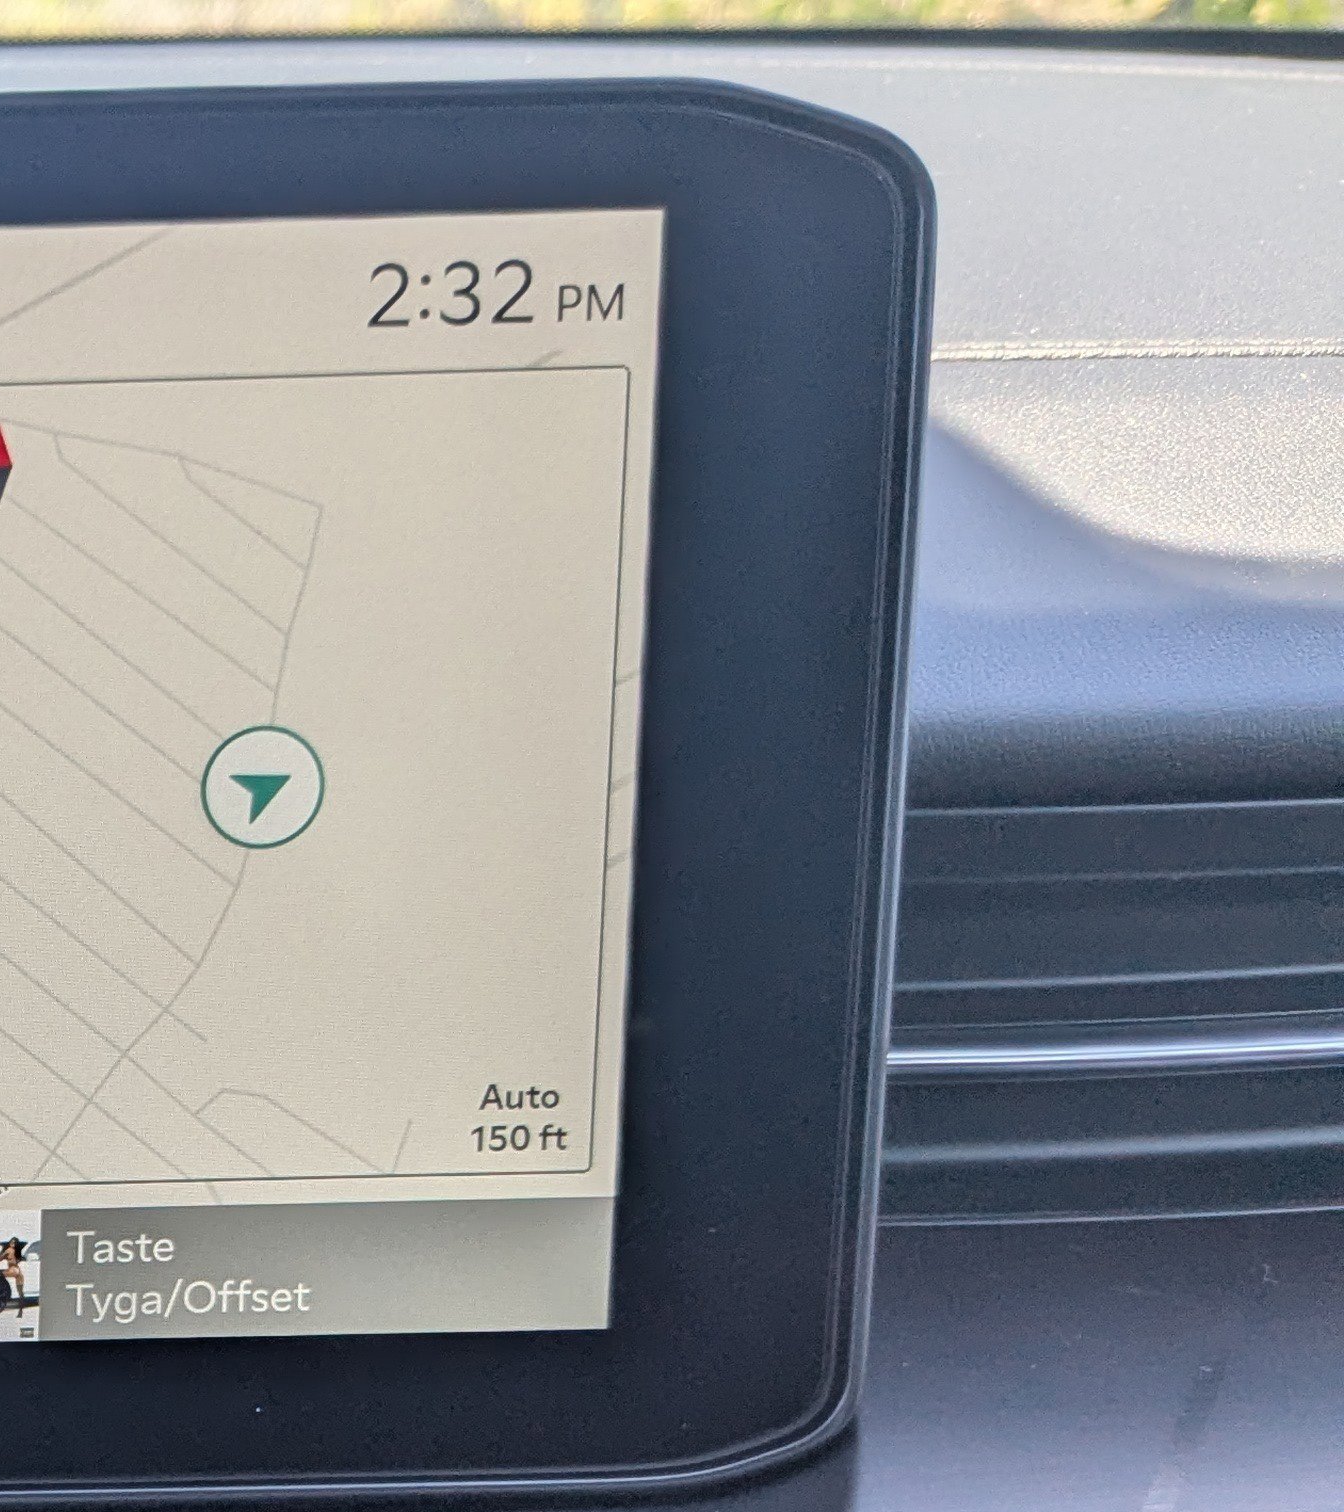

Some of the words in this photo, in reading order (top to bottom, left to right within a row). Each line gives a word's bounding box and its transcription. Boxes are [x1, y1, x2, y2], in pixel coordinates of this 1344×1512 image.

[367, 258, 534, 328] 2:32
[556, 283, 626, 323] PM
[478, 1083, 561, 1111] Auto
[470, 1125, 531, 1153] 150
[538, 1123, 568, 1151] ft
[66, 1229, 176, 1264] Taste
[65, 1279, 313, 1325] Tyga/Offset
